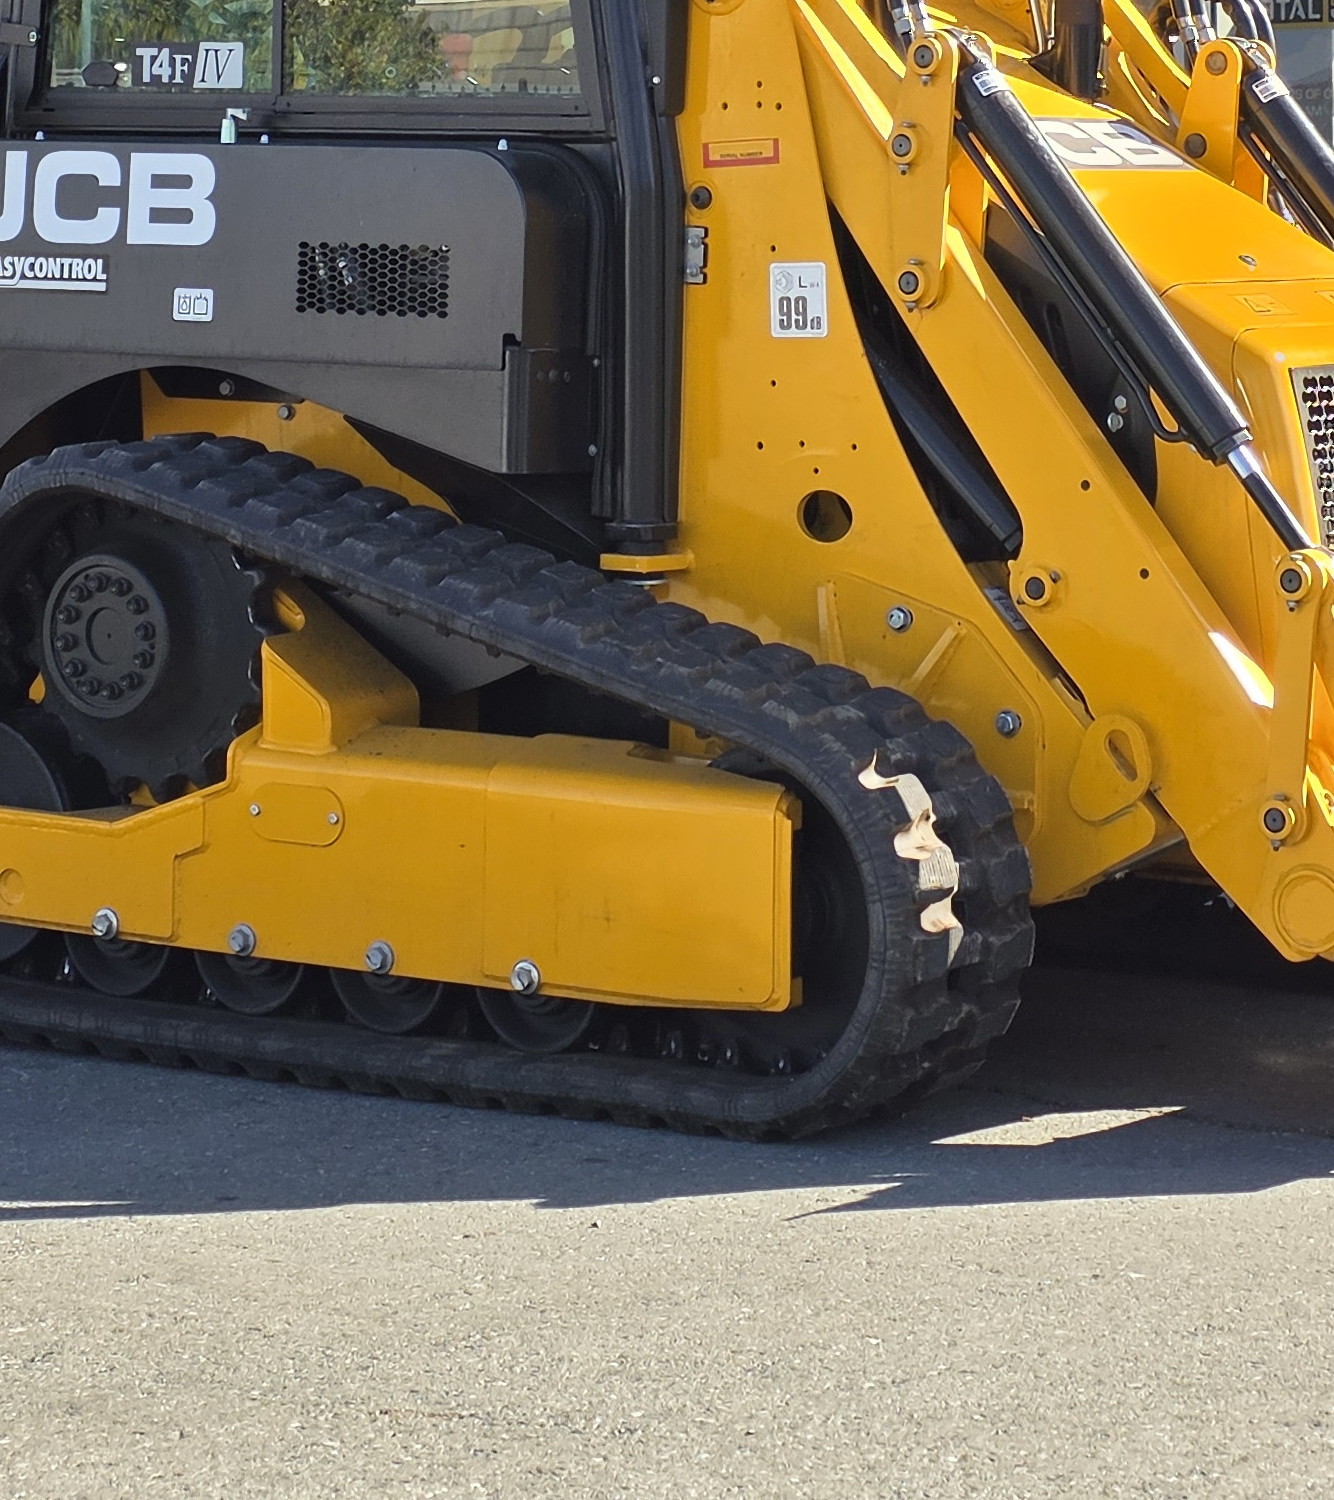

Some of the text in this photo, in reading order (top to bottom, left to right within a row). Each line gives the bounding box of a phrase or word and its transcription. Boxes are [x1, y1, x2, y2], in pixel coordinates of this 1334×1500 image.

[135, 48, 236, 83] T4F IV
[1034, 120, 1184, 166] CB
[779, 296, 822, 330] 99 dB
